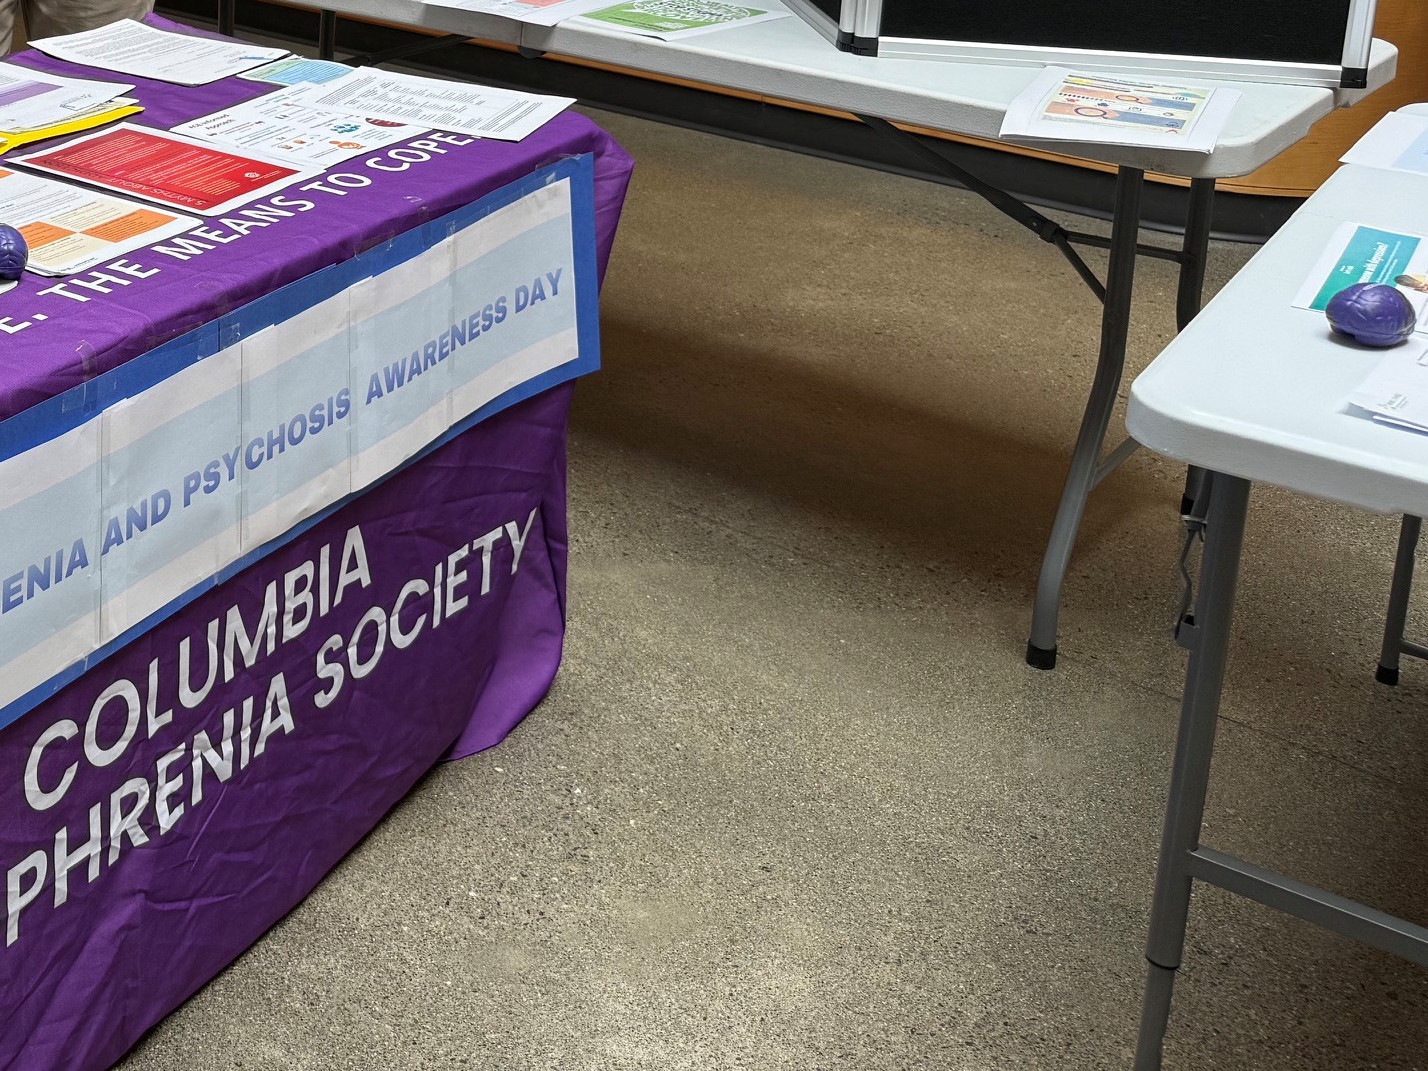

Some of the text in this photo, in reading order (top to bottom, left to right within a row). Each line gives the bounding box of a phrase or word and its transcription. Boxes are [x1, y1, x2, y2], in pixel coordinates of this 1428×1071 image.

[37, 257, 162, 303] THE
[161, 193, 316, 262] MEANS
[300, 170, 373, 202] TO
[102, 488, 172, 557] AND
[182, 387, 350, 510] PSYCHOSIS
[365, 297, 508, 405] AWARENESS
[514, 269, 563, 313] DAY
[24, 525, 371, 813] COLUMBIA
[313, 506, 542, 708] SOCIETY
